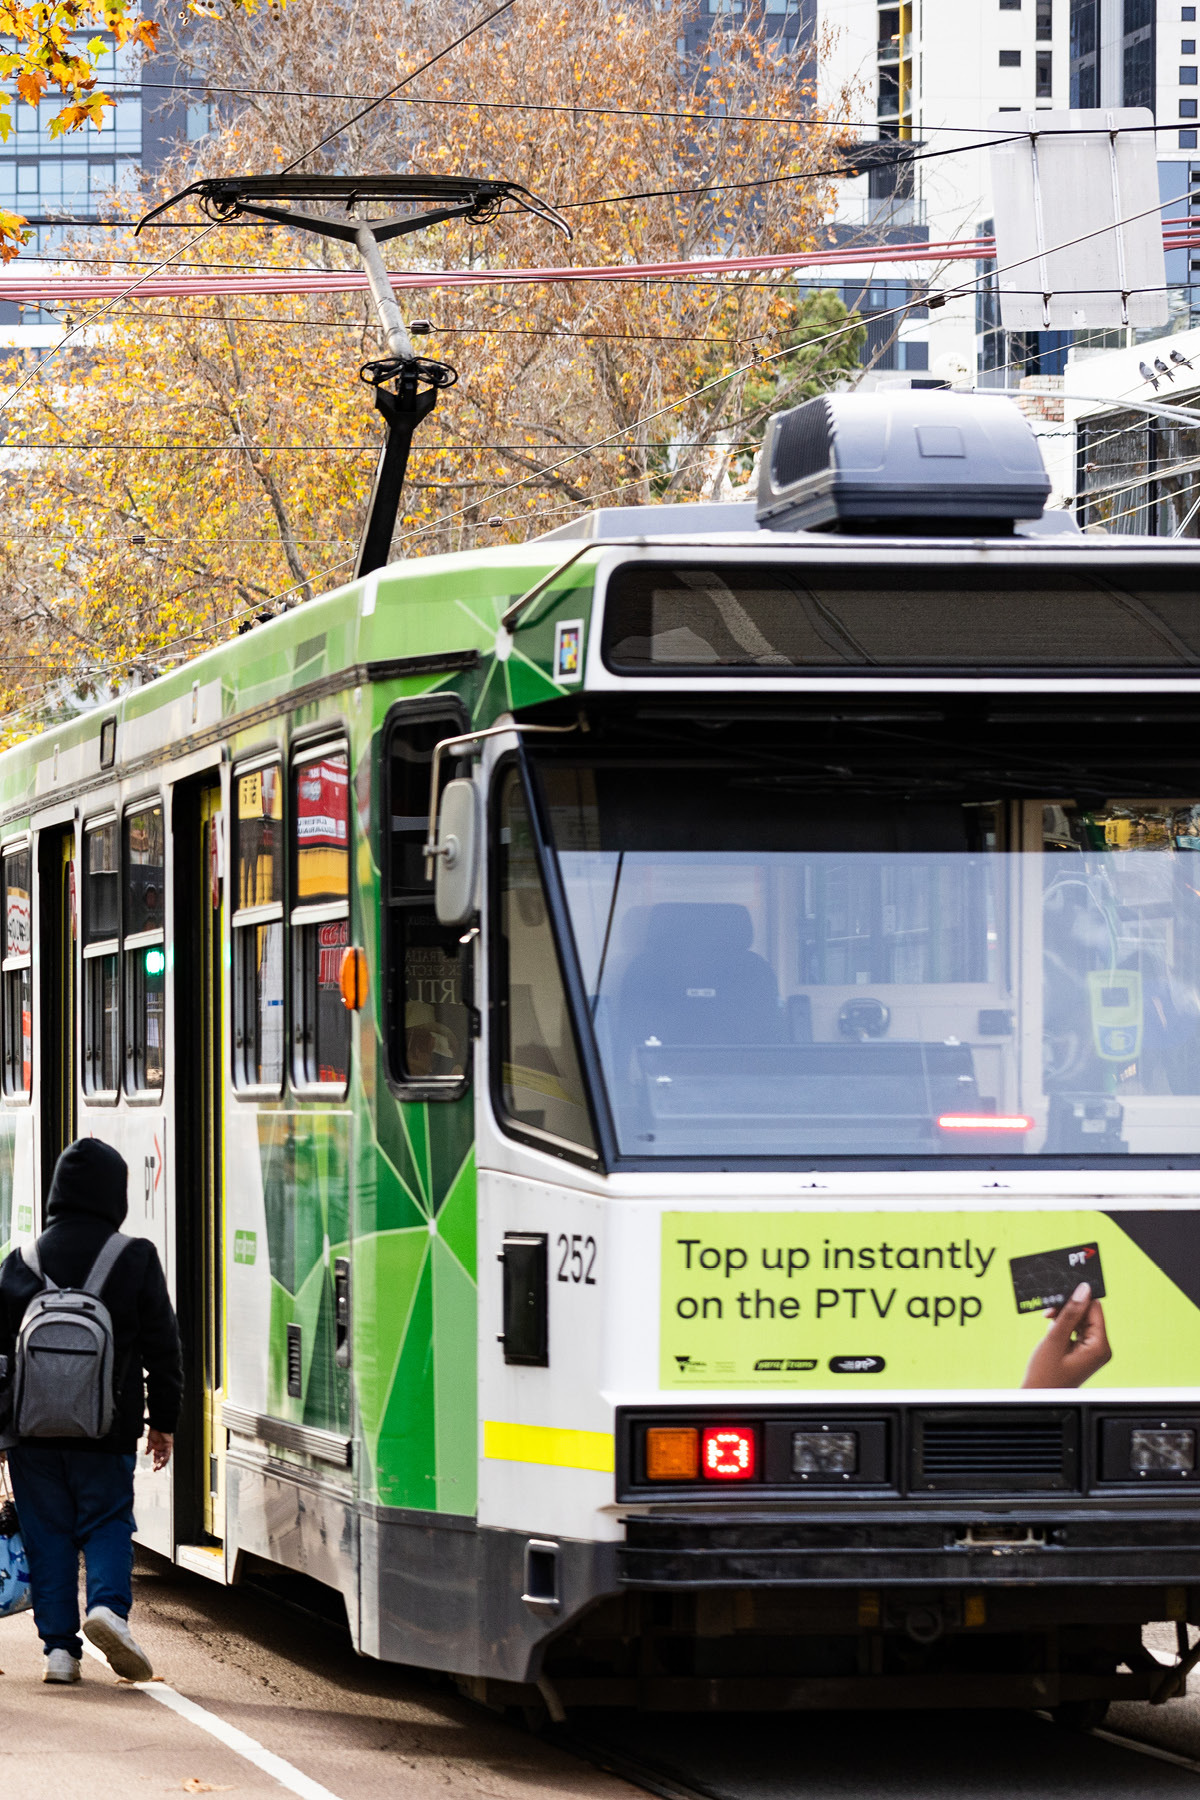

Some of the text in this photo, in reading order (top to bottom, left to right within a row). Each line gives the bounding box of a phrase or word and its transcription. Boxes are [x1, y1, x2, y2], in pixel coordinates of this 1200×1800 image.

[557, 1233, 597, 1285] 252
[677, 1239, 996, 1278] Top up instantly
[676, 1288, 982, 1327] on the PTV app
